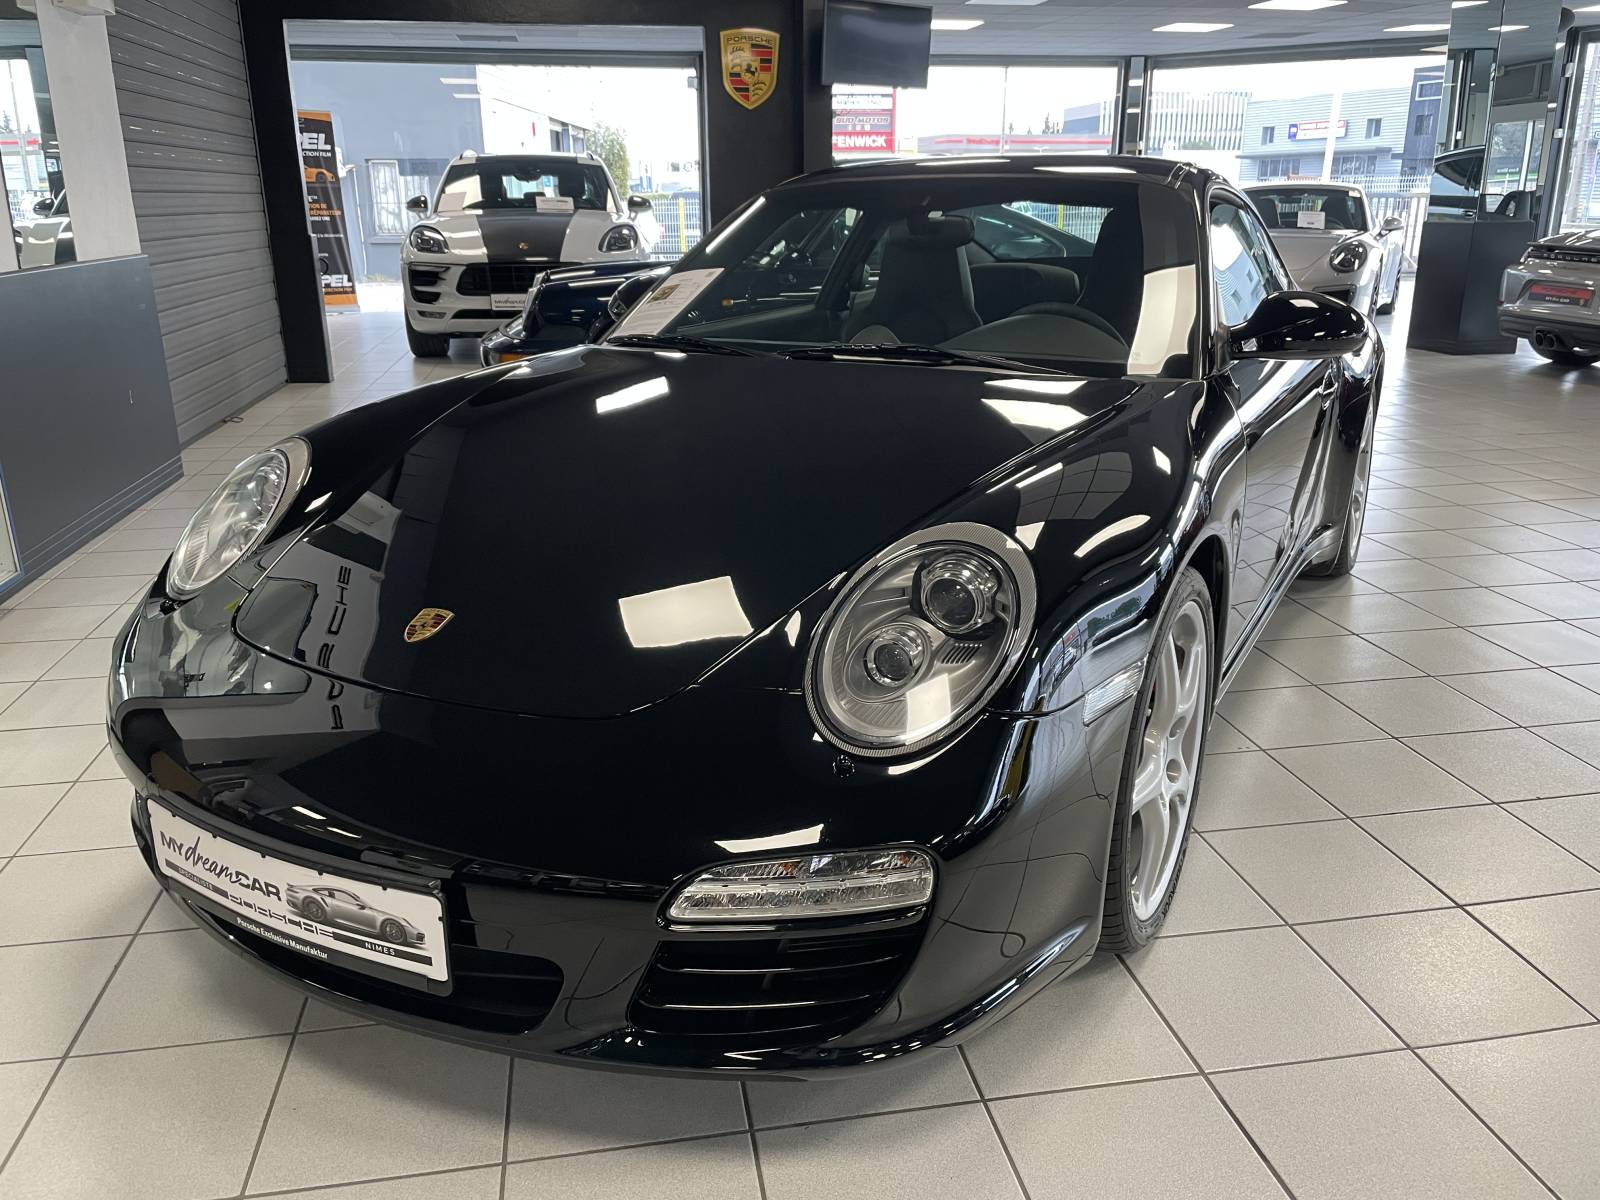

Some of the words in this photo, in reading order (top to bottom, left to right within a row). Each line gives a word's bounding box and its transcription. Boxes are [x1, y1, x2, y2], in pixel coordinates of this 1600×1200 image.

[726, 35, 774, 46] PORSCHE
[301, 132, 332, 150] EL
[832, 134, 887, 148] FENWICK
[321, 274, 353, 288] PEL
[236, 917, 261, 935] Porsche
[260, 927, 290, 947] Exclusive
[290, 939, 329, 960] Manufaktur
